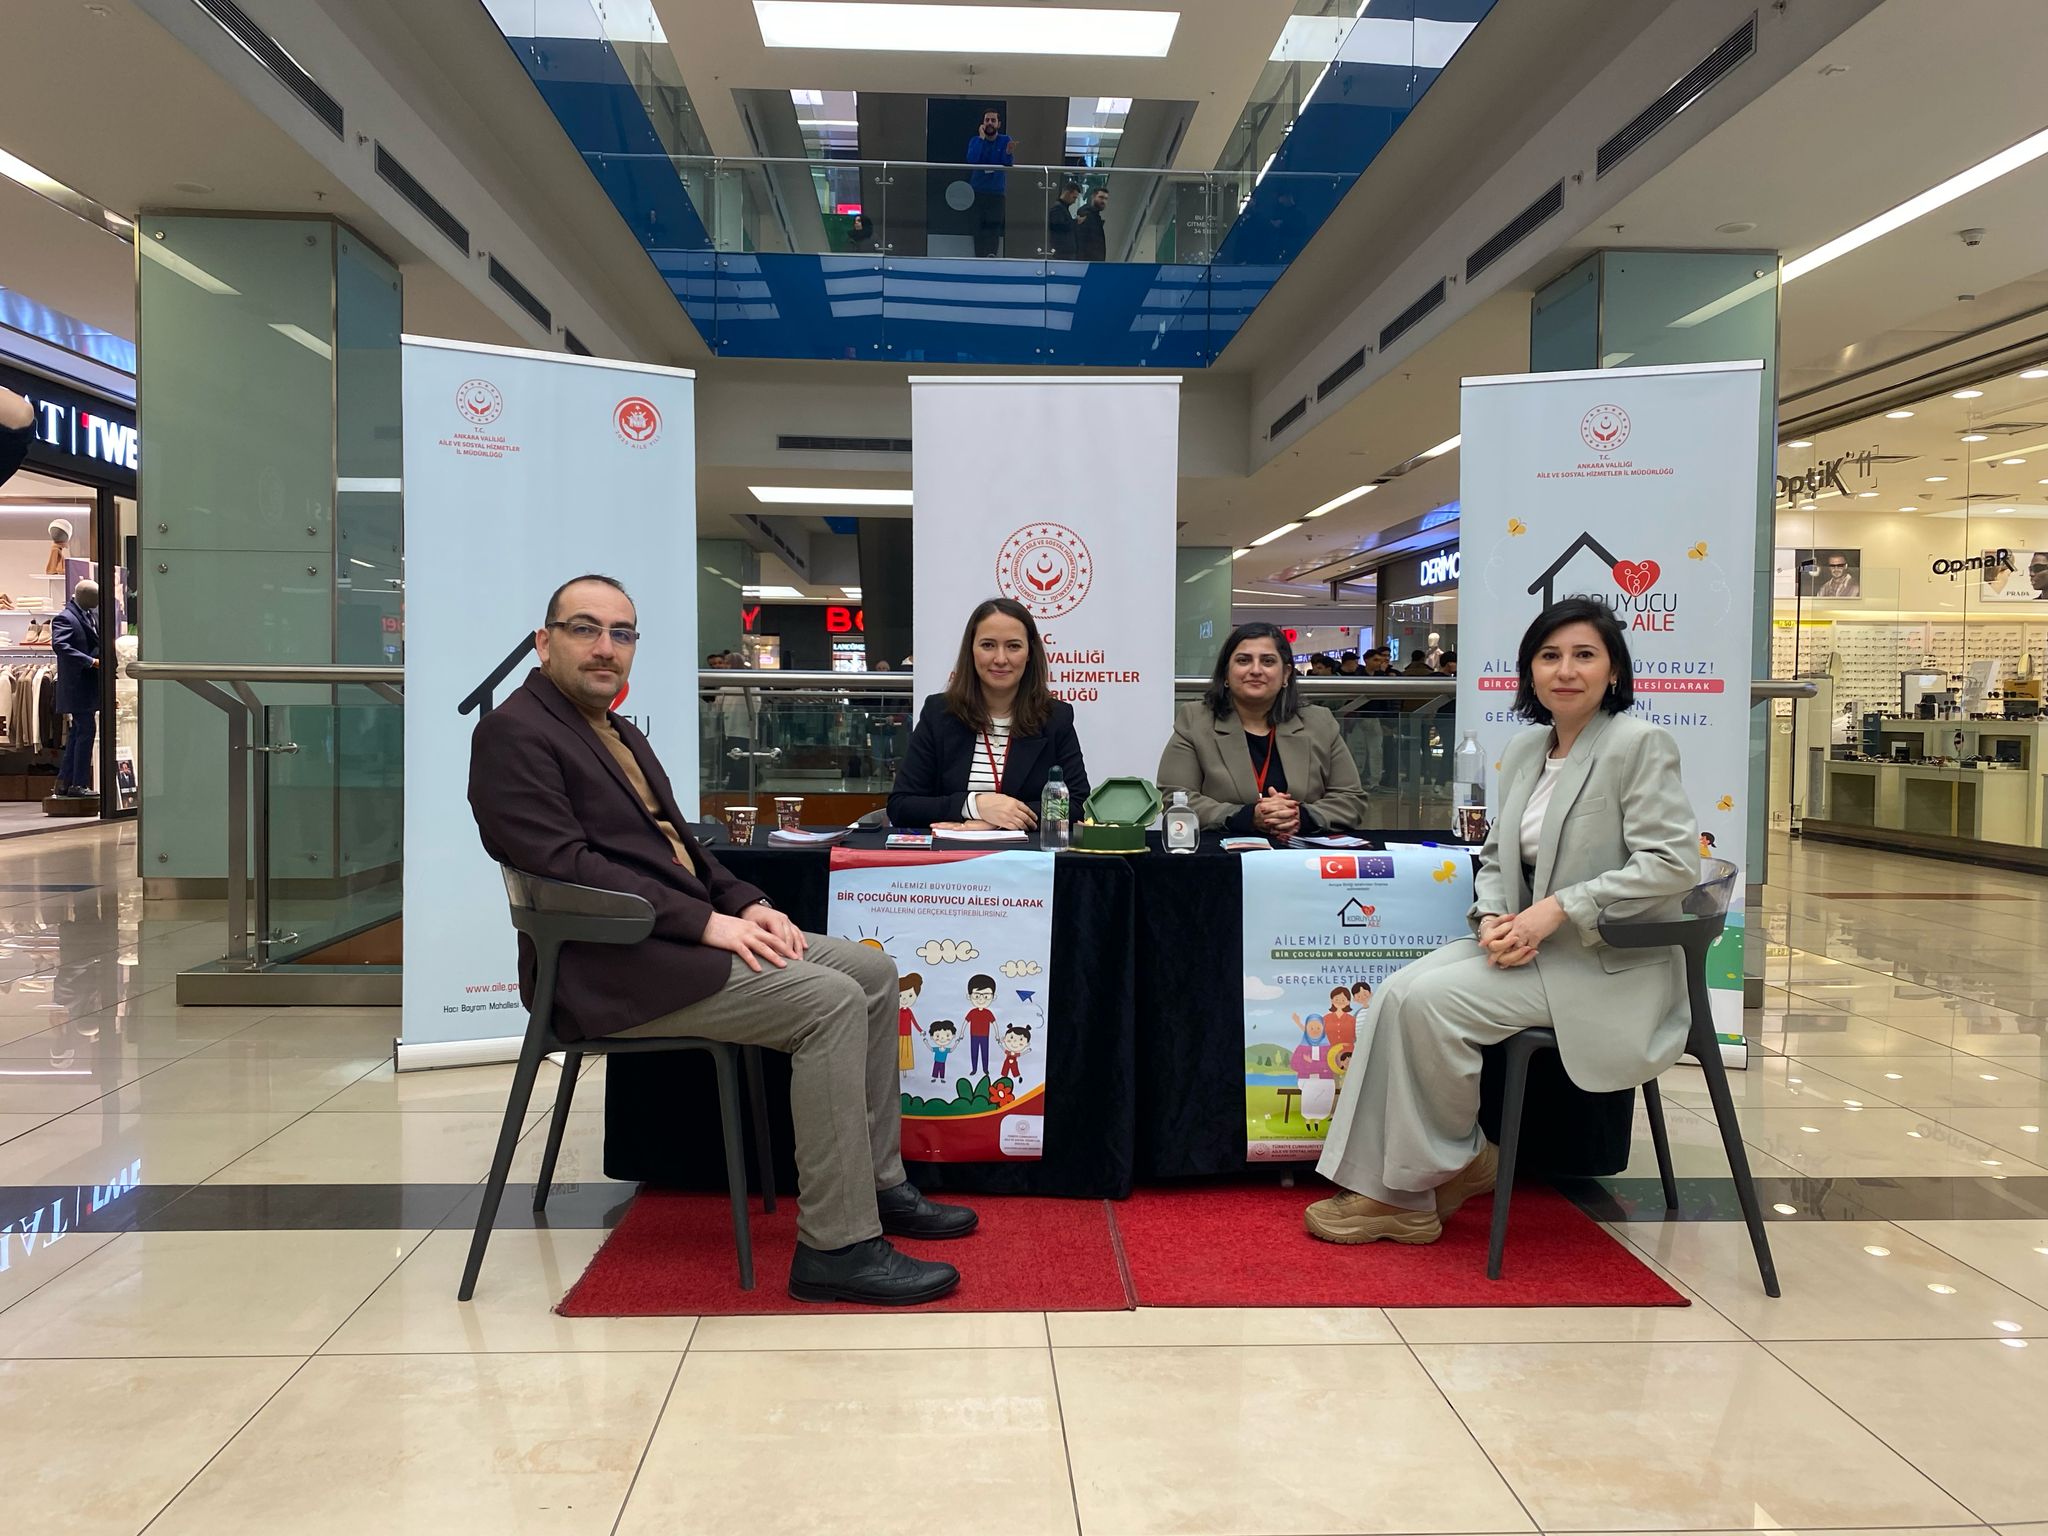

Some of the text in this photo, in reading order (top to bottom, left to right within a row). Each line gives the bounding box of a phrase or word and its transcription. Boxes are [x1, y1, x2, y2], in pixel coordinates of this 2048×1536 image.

[81, 412, 137, 470] TWE
[453, 433, 480, 441] ANKARA
[486, 444, 520, 452] HİZMETLER
[1420, 549, 1460, 587] DERİMO
[741, 606, 760, 632] Y
[1632, 609, 1675, 631] AİLE
[1043, 633, 1057, 645] C.
[1047, 650, 1105, 664] VALİLİĞİ
[1633, 659, 1714, 674] ÜYORUZ!
[1060, 668, 1140, 683] HİZMETLER
[1484, 679, 1502, 688] BİR
[1633, 681, 1661, 689] İLESİ
[1664, 682, 1710, 690] OLARAK
[1050, 688, 1098, 702] RLÜĞÜ
[891, 881, 991, 892] AİLEMİZİ BÜYÜTÜYORUZ!
[837, 890, 1044, 908] BİR ÇOCUĞUN KORUYUCU AİLESİ OLARAK
[871, 906, 916, 915] HAYALLERİNİ
[1275, 934, 1448, 946] AİLEMİZİ BÜYÜTÜYORUZ!
[1275, 950, 1289, 958] BİR
[1292, 950, 1333, 959] ÇOCUĞUN
[1386, 950, 1413, 958] AİLESİ
[443, 1001, 519, 1014] Hacı Bayram Mahallesi
